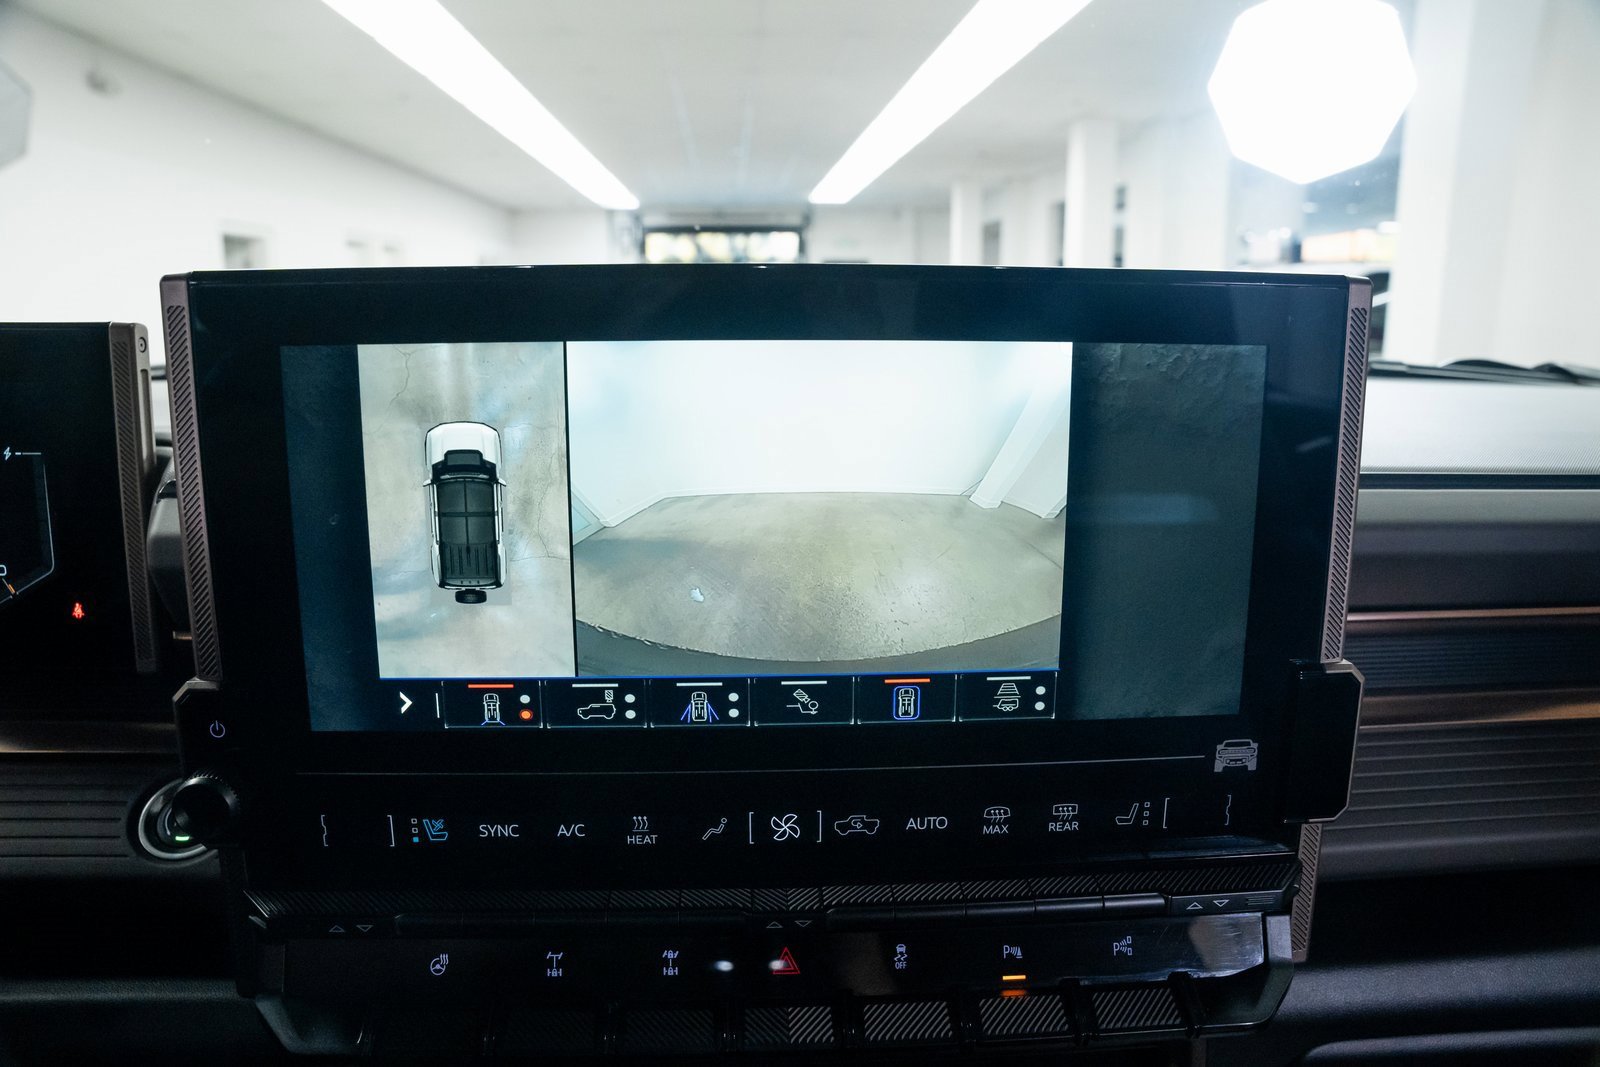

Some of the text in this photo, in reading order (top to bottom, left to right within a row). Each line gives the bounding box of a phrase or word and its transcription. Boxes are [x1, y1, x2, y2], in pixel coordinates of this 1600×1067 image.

[905, 816, 948, 831] AUTO
[1048, 821, 1079, 832] REAR
[478, 824, 520, 838] SYNC
[557, 823, 586, 838] A/C
[982, 824, 1010, 835] MAX
[627, 834, 658, 845] HEAT
[894, 960, 908, 970] OFF
